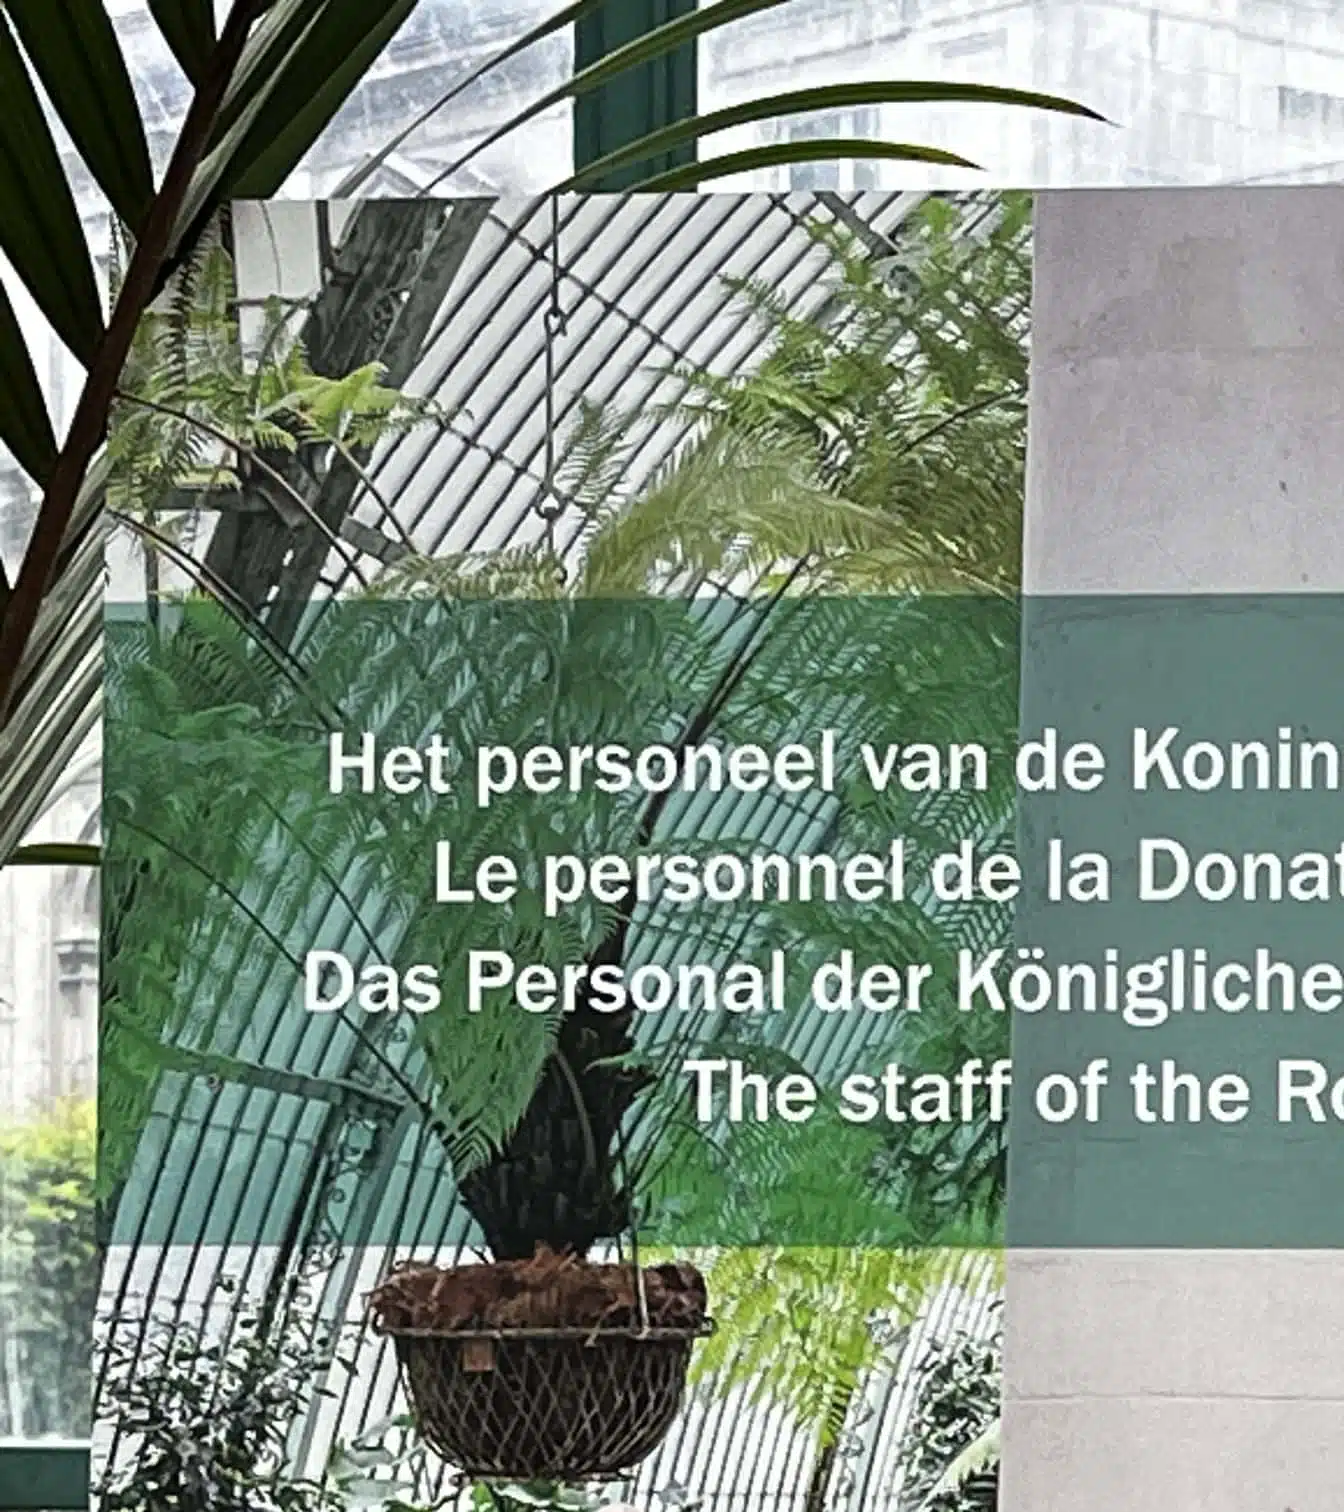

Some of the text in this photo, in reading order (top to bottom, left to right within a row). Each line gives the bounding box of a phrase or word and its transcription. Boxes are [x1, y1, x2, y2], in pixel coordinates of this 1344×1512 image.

[329, 731, 450, 794] Het
[478, 729, 834, 807] personeel
[861, 743, 987, 792] van
[1016, 728, 1105, 791] de
[436, 840, 518, 903] Le
[545, 838, 904, 917] personnel
[931, 839, 1022, 902] de
[1049, 838, 1108, 901] la
[305, 950, 440, 1013] Das
[469, 950, 784, 1013] Personal
[812, 950, 931, 1012] der
[682, 1059, 816, 1122] The
[840, 1059, 1013, 1123] staff
[1036, 1059, 1108, 1123] of
[1129, 1059, 1250, 1123] the
